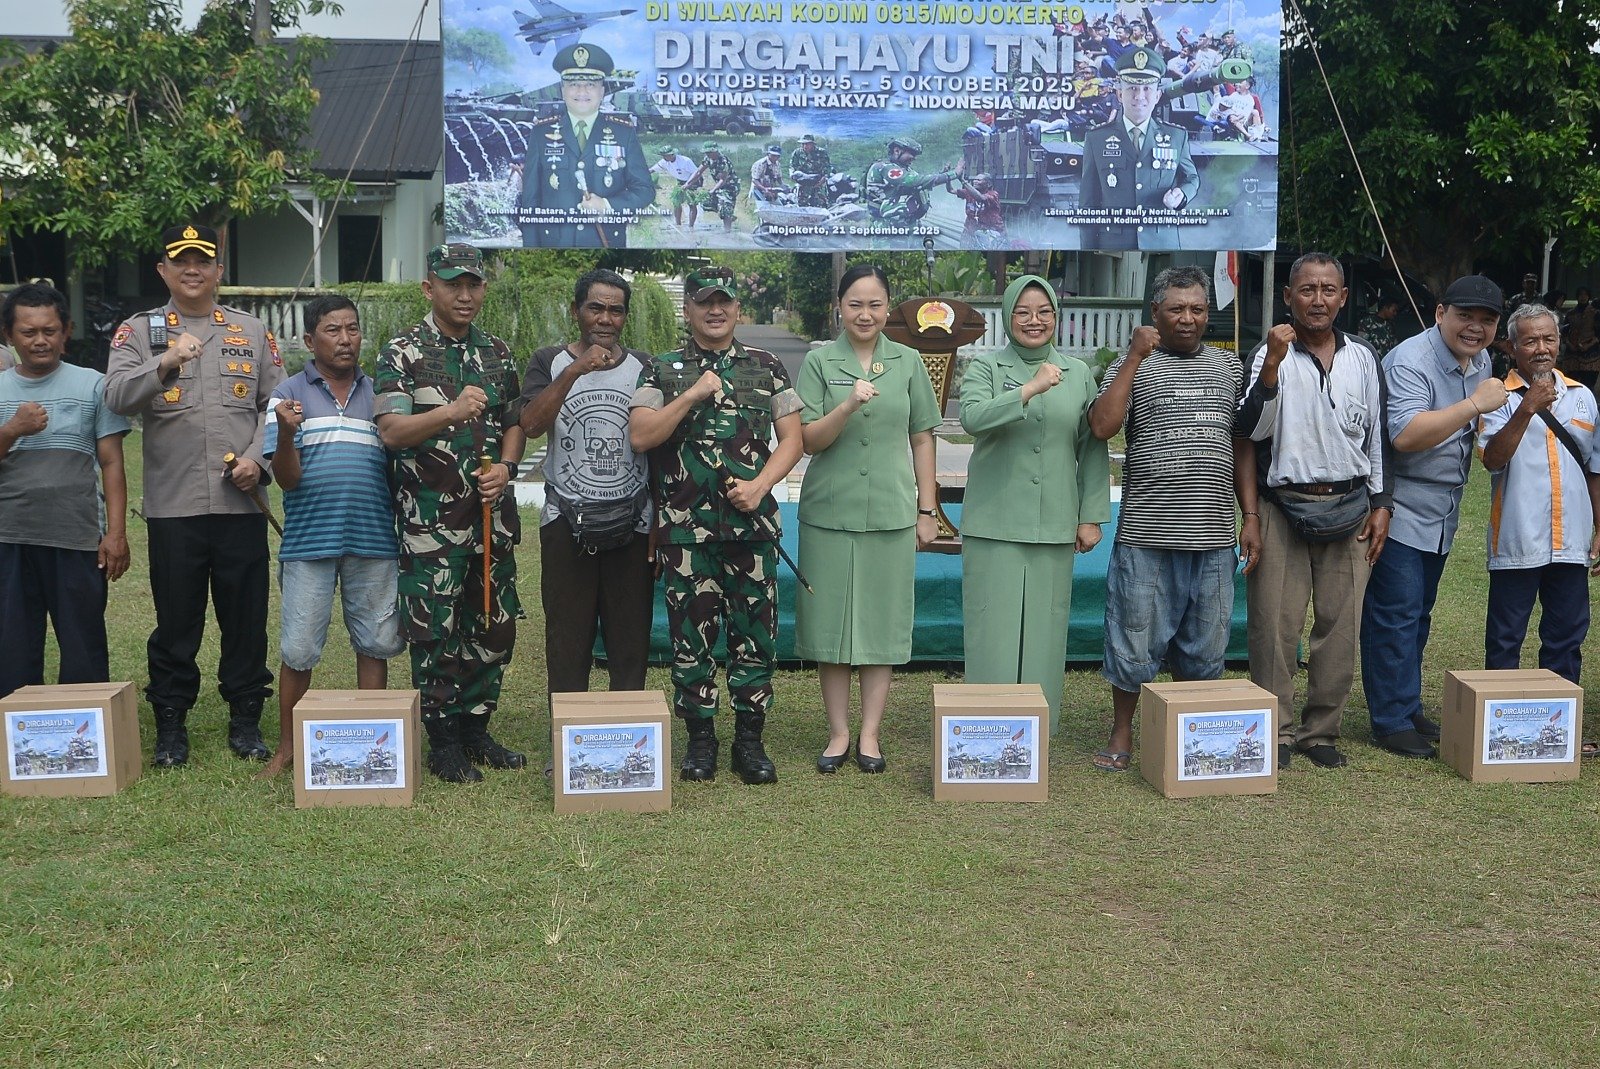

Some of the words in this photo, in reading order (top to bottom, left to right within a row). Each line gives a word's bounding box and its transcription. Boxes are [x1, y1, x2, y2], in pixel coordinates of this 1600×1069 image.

[646, 2, 669, 21] DI
[678, 2, 782, 22] WILAYAH
[791, 3, 868, 23] KODIM
[876, 4, 1084, 25] 0815/MOJOKERTO
[655, 30, 970, 74] DIRGAHAYU
[984, 34, 1074, 74] TNI
[656, 72, 668, 88] 5
[678, 72, 786, 90] OKTOBER
[799, 74, 851, 90] 1945
[879, 75, 892, 90] 5
[901, 75, 1008, 91] OKTOBER
[1018, 76, 1073, 93] 2025
[656, 91, 687, 106] TNI
[693, 92, 756, 106] PRIMA
[778, 93, 807, 107] TNI
[814, 94, 889, 108] RAKYAT
[909, 95, 1013, 109] INDONESIA
[1019, 96, 1075, 110] MAJU
[485, 207, 518, 215] Kolonel
[520, 207, 532, 215] Inf
[535, 207, 567, 216] Batara,
[580, 207, 600, 215] Hub.
[1045, 208, 1075, 216] Letnan
[1077, 208, 1109, 216] Kolonel
[1111, 208, 1123, 216] Inf
[1125, 208, 1147, 217] Rully
[1149, 208, 1179, 217] Noriza,
[519, 216, 564, 224] Komandan
[567, 216, 595, 224] Korem
[1143, 217, 1208, 226] 0815/Mojokerto
[768, 225, 829, 236] Mojokerto,
[832, 226, 846, 234] 21
[849, 226, 910, 236] September
[913, 226, 940, 235] 2025
[221, 347, 254, 358] POLRI
[570, 397, 587, 410] LIVE
[587, 393, 604, 402] FOR
